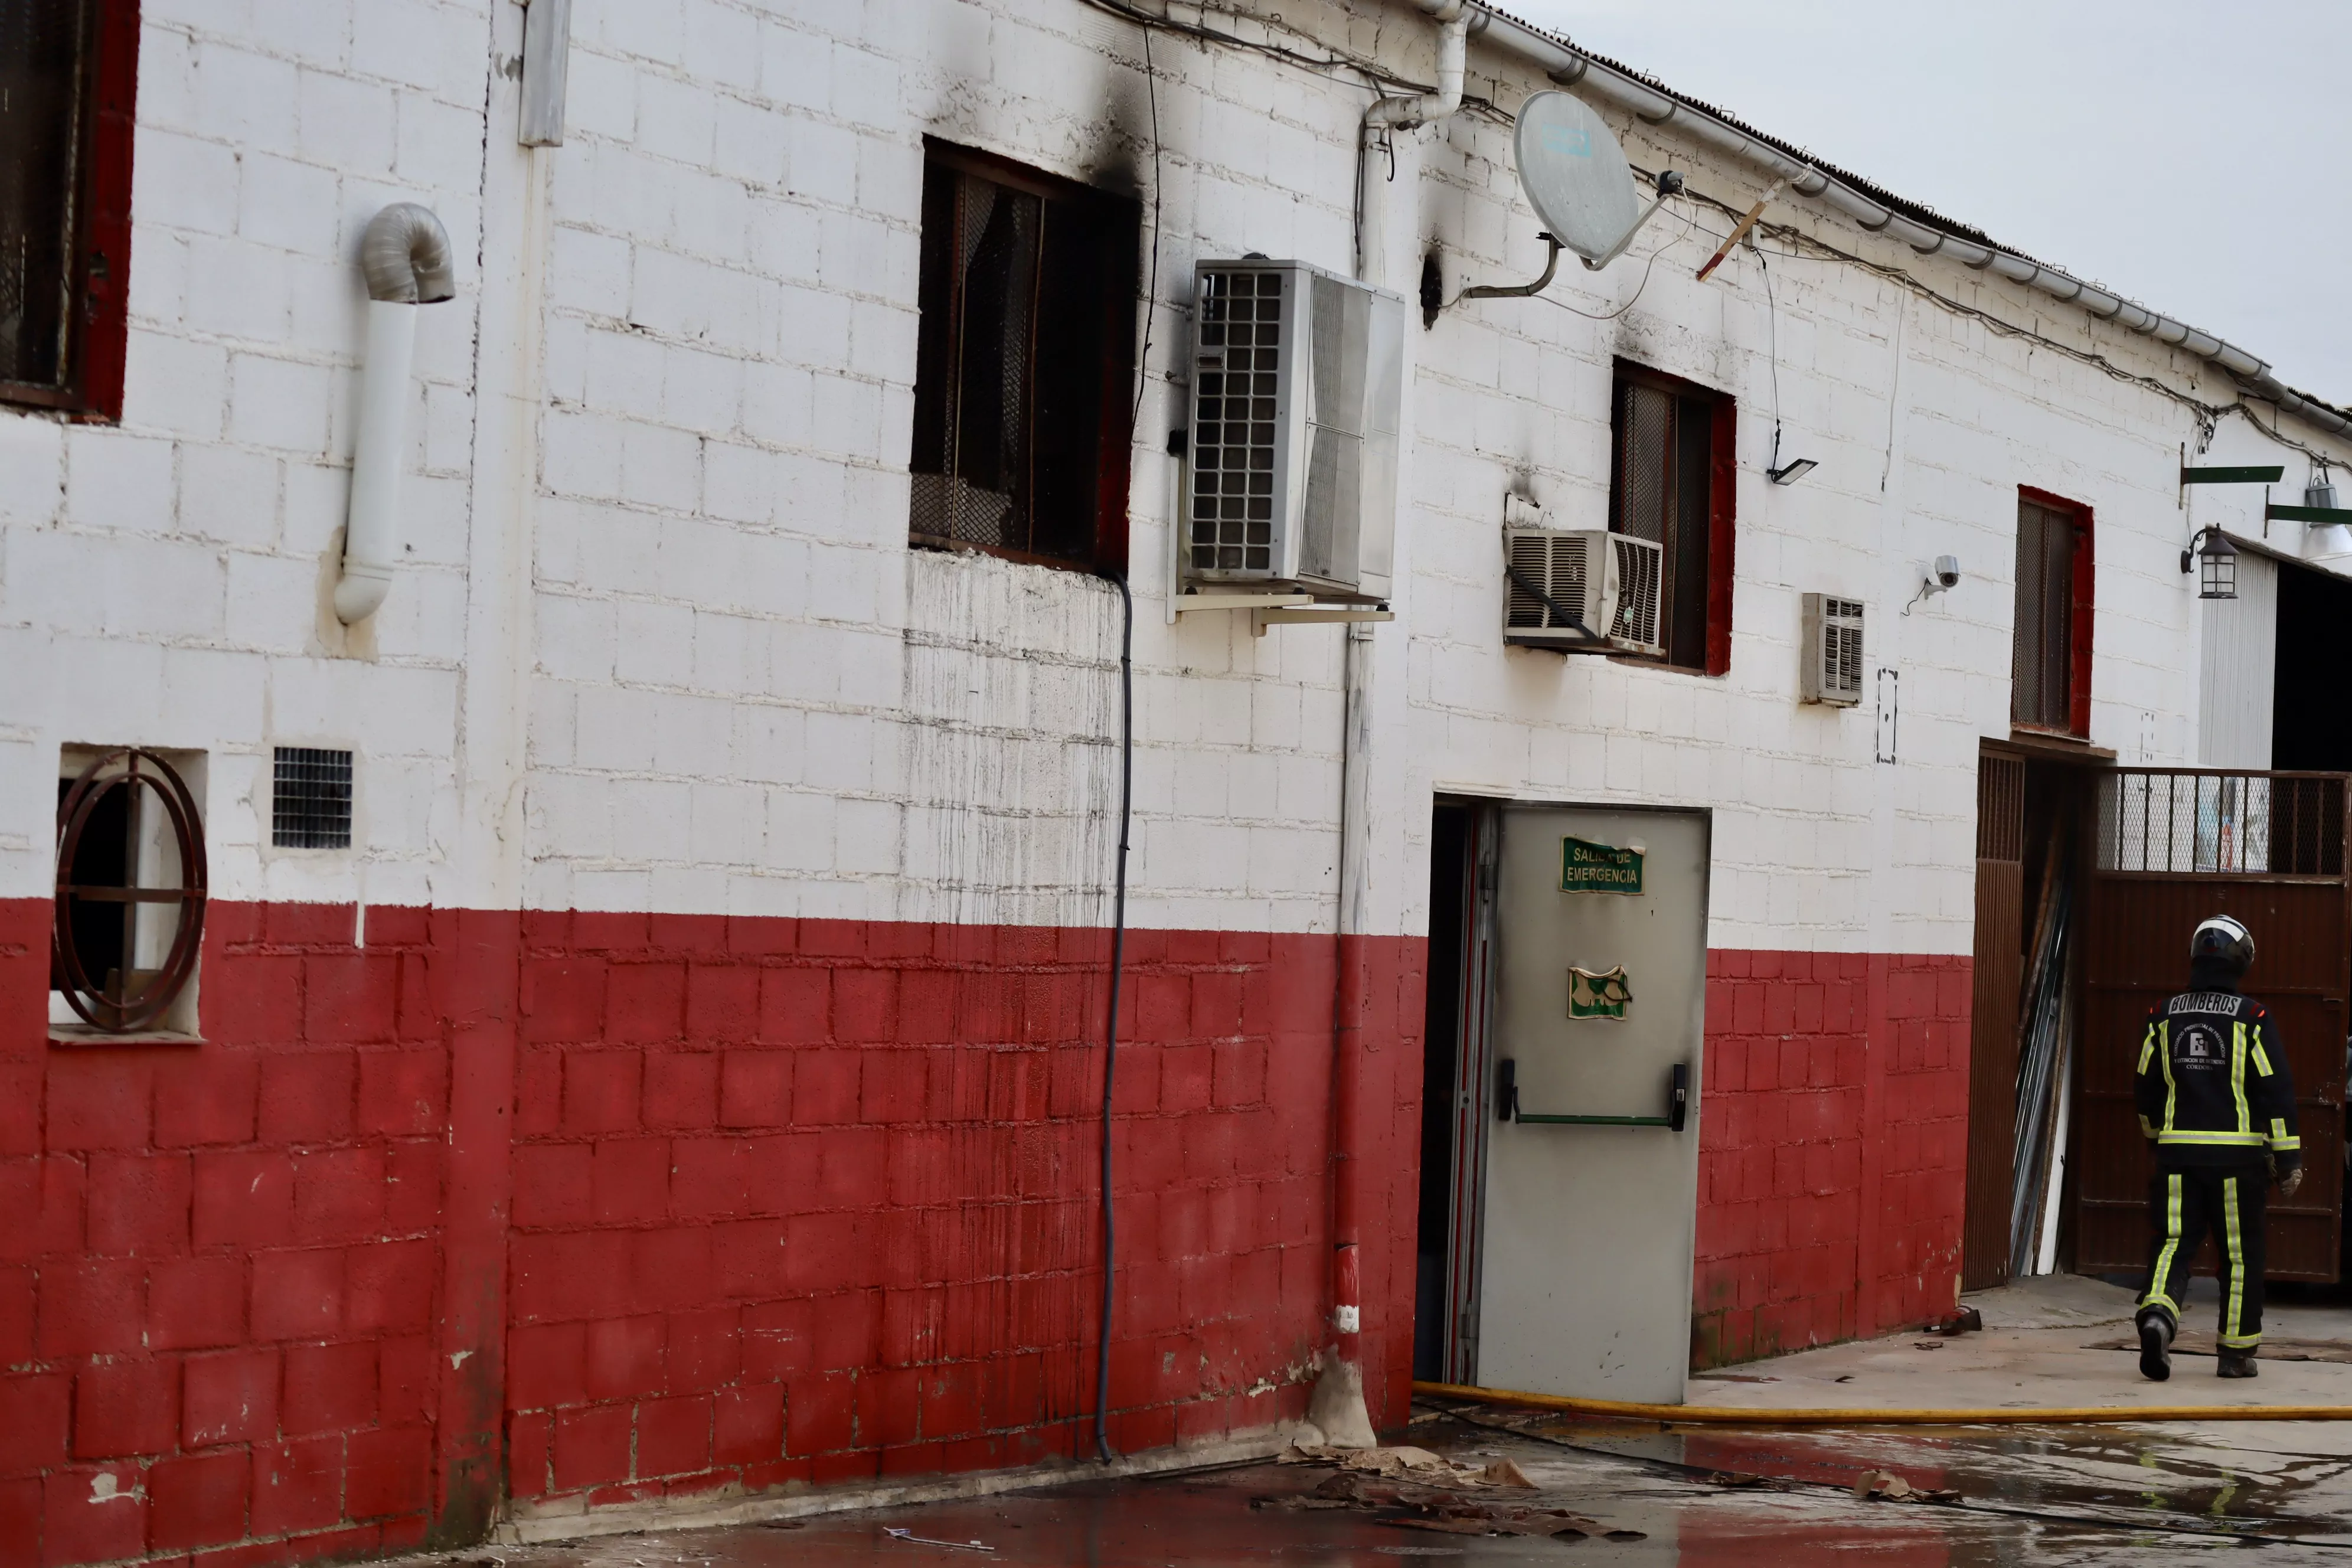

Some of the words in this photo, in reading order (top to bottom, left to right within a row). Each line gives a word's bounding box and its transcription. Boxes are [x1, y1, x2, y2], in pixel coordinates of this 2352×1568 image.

[1616, 852, 1631, 864] DE
[1567, 867, 1637, 884] EMERGENCIA
[2172, 993, 2238, 1013] BOMBEROS
[2174, 1031, 2184, 1056] CONSORCIO
